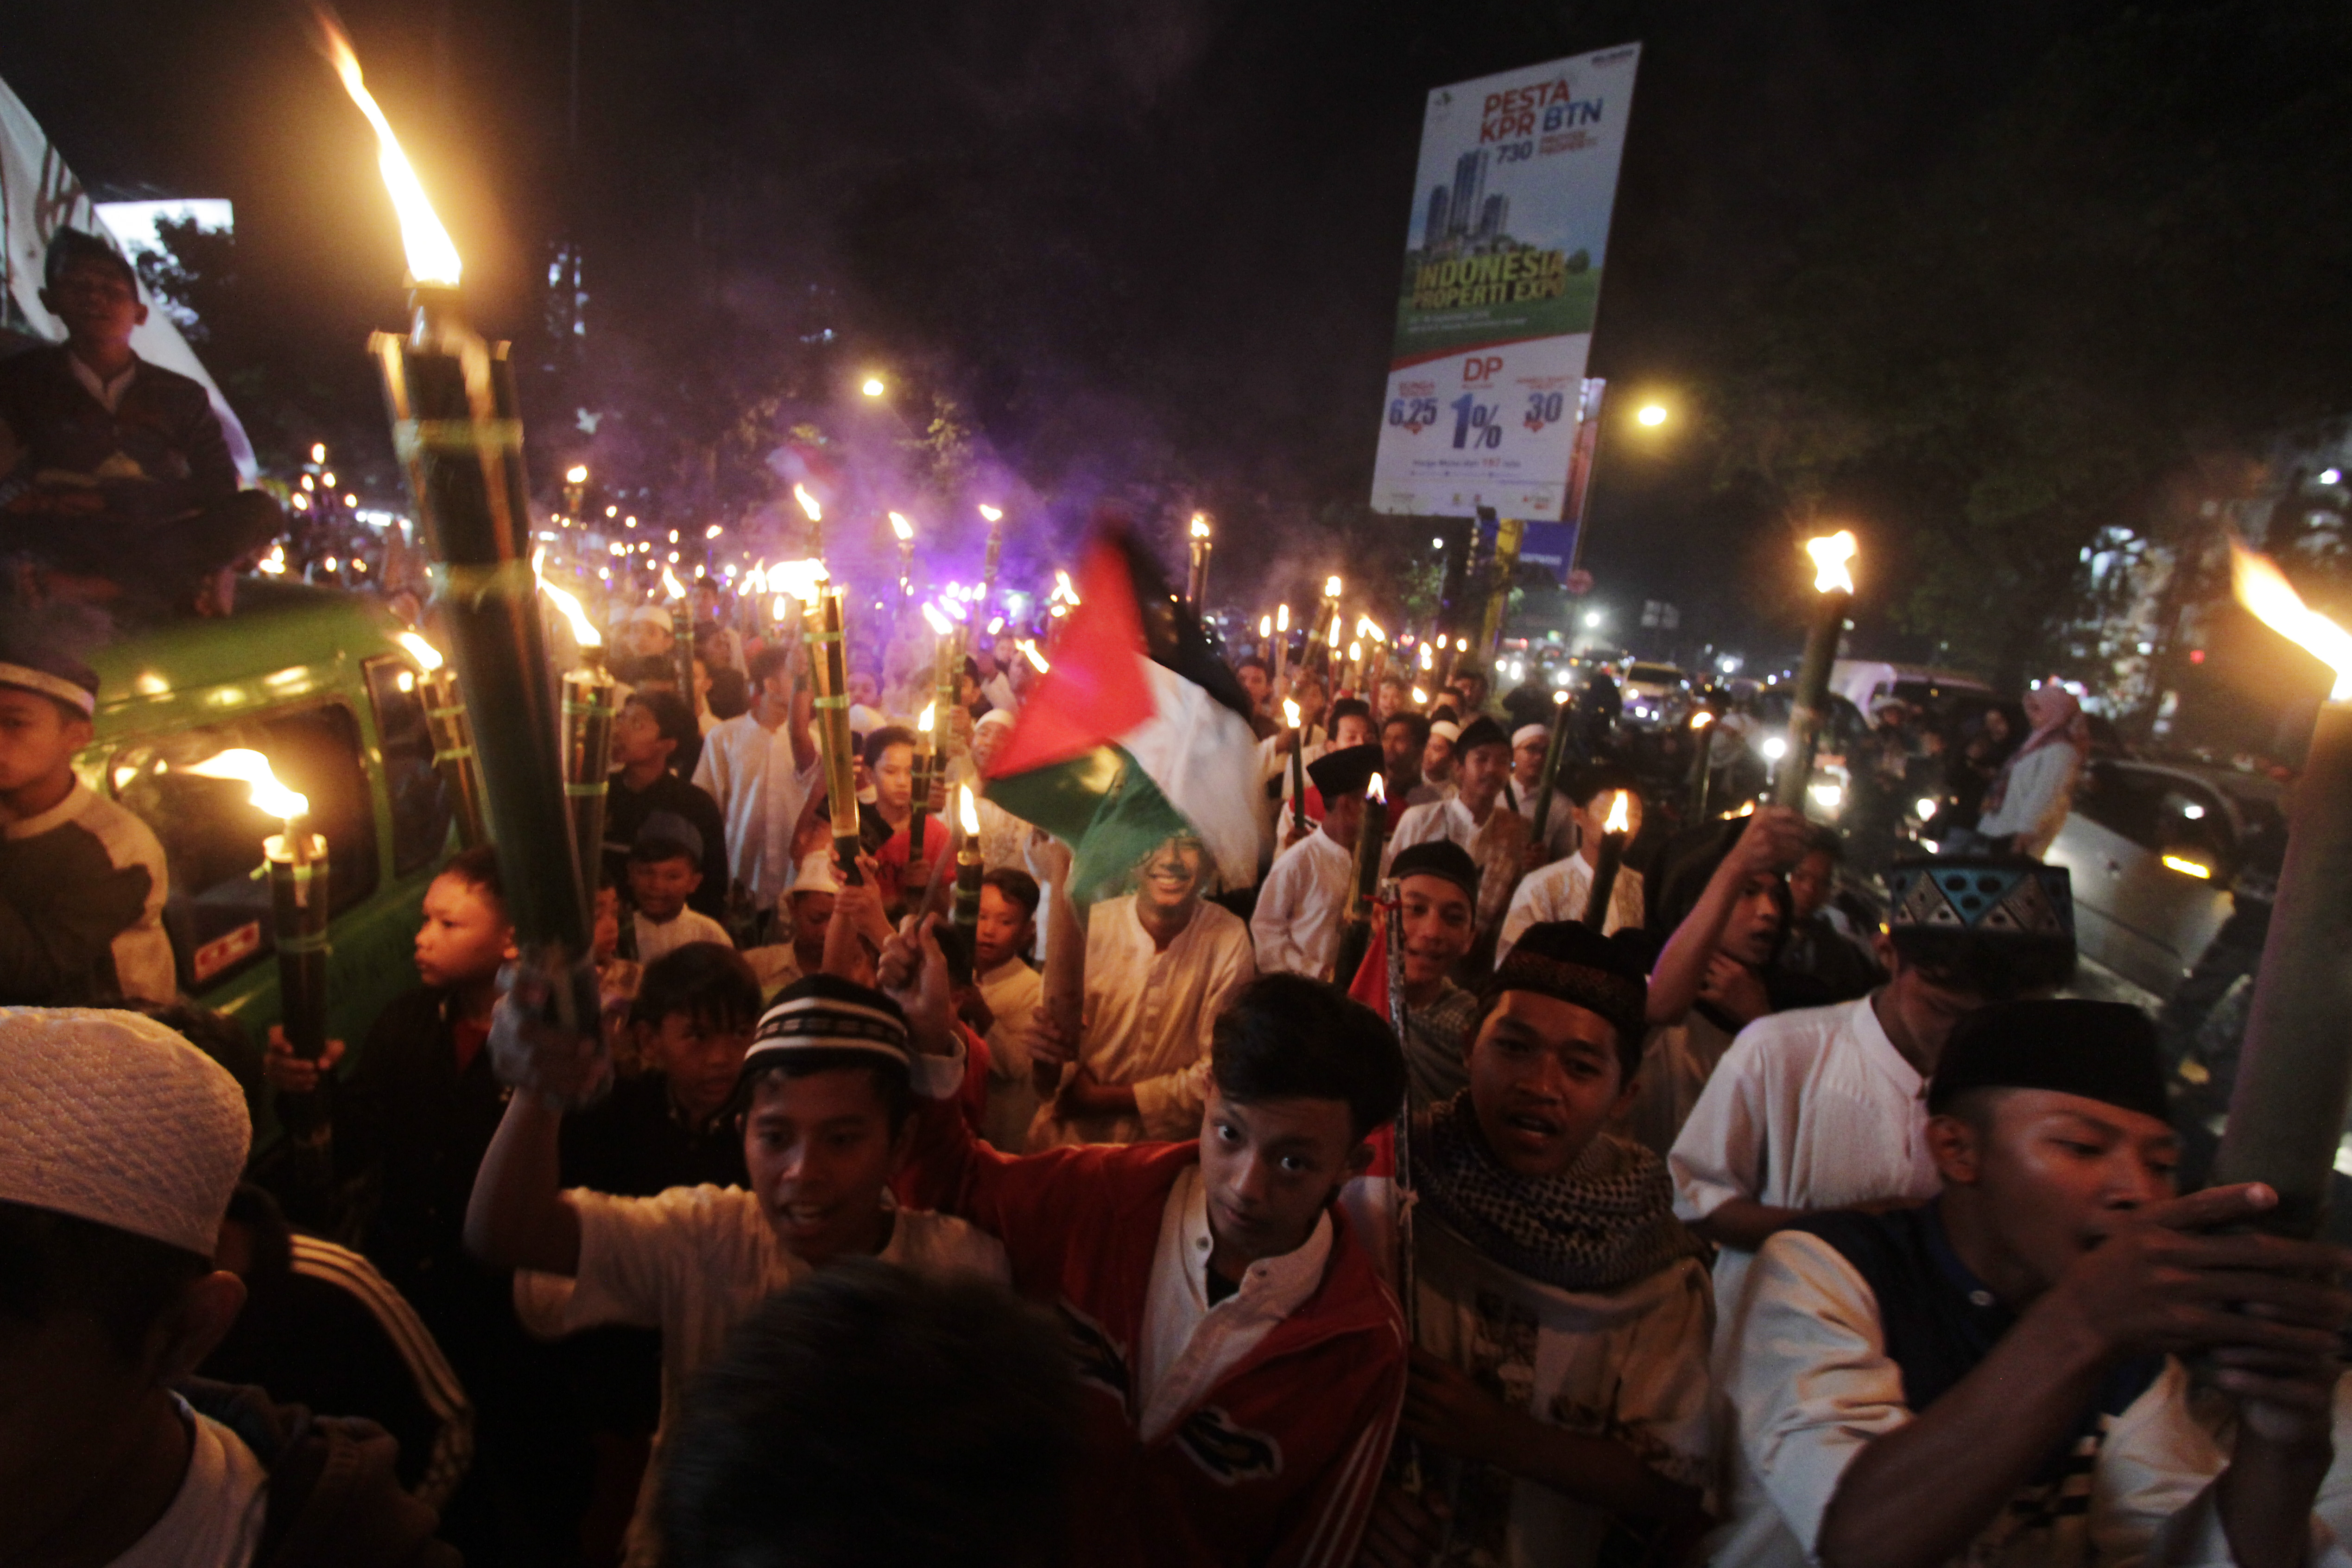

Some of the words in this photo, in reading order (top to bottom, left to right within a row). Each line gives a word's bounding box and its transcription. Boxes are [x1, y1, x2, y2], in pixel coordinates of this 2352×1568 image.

[1483, 80, 1570, 118] PESTA
[1480, 111, 1536, 144] KPR
[1543, 97, 1604, 132] BTN
[1415, 250, 1566, 289] INDONESIA
[1463, 357, 1504, 381] DP
[1451, 392, 1502, 449] 1%
[1525, 392, 1563, 422] 30
